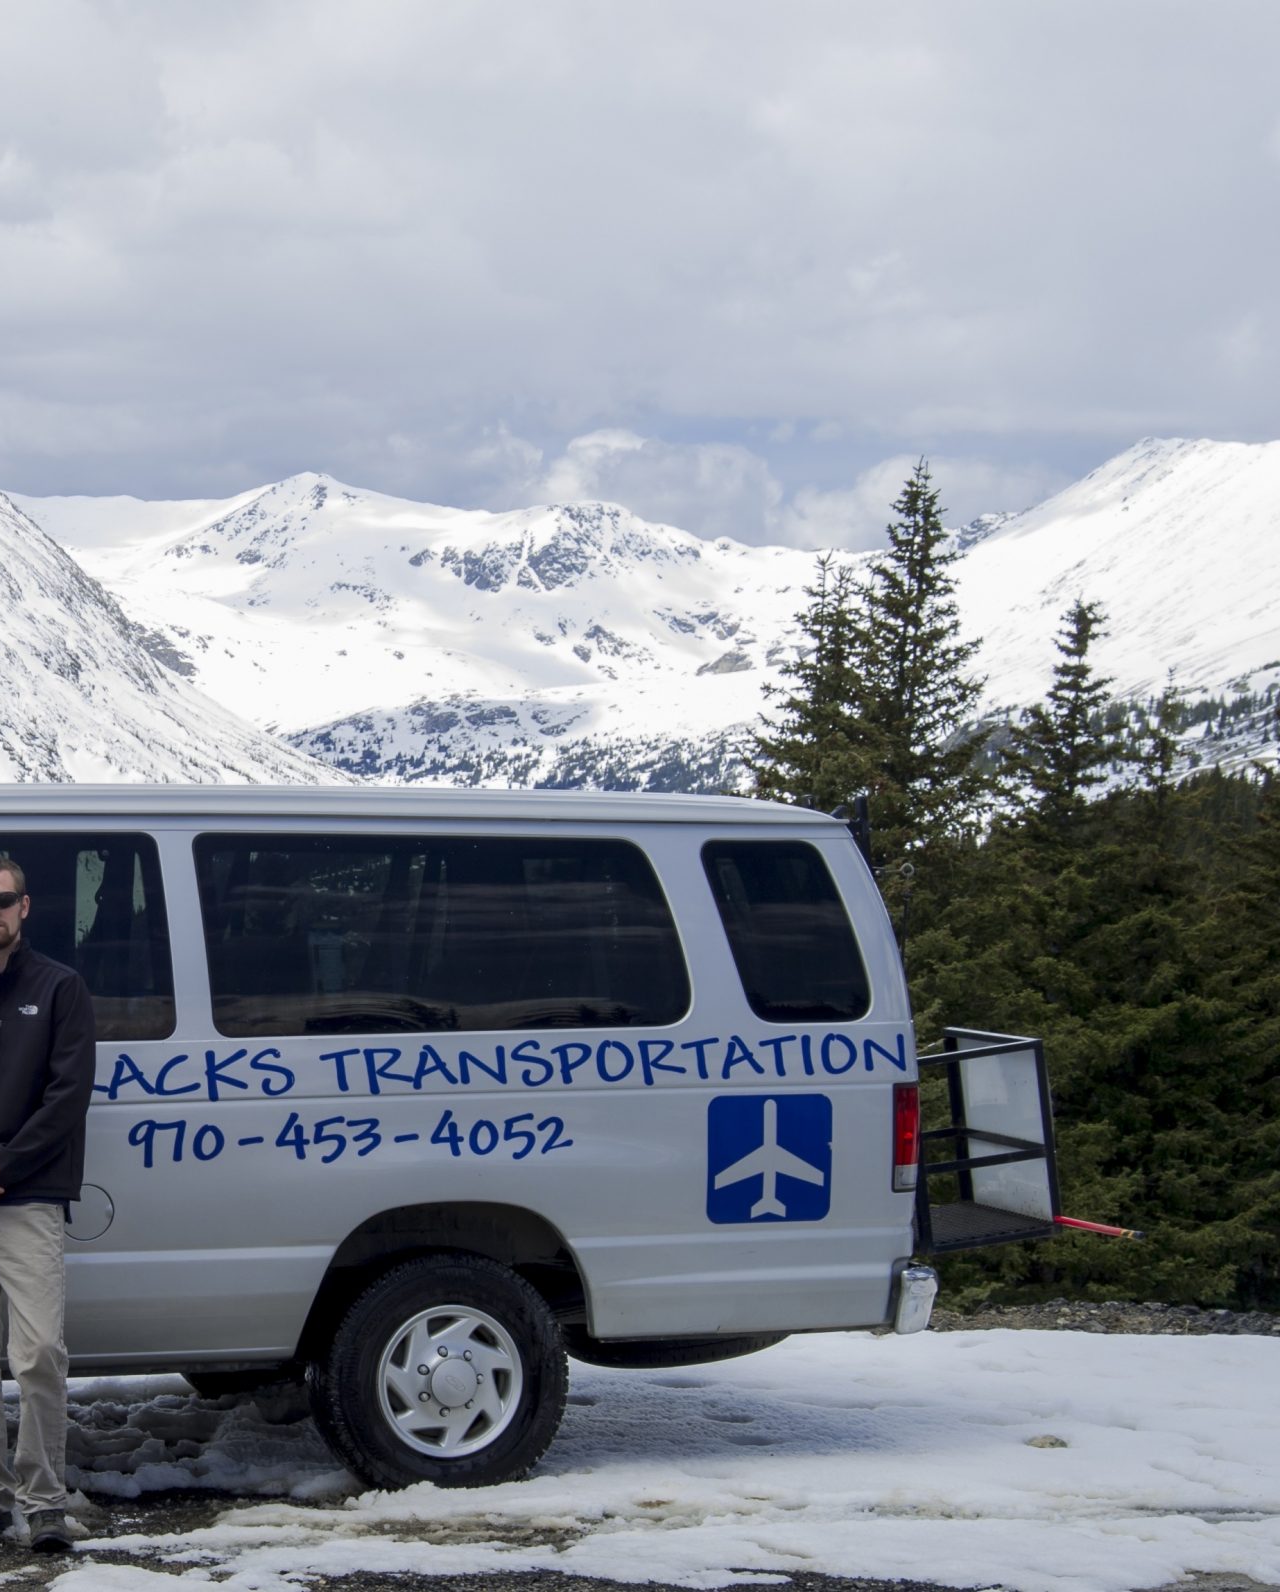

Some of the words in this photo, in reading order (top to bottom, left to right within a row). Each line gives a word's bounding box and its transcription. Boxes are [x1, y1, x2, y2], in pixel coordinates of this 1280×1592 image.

[93, 1048, 296, 1102] ACKS
[319, 1032, 907, 1095] TRANSPORTATION
[128, 1110, 574, 1169] 970-453-4052
